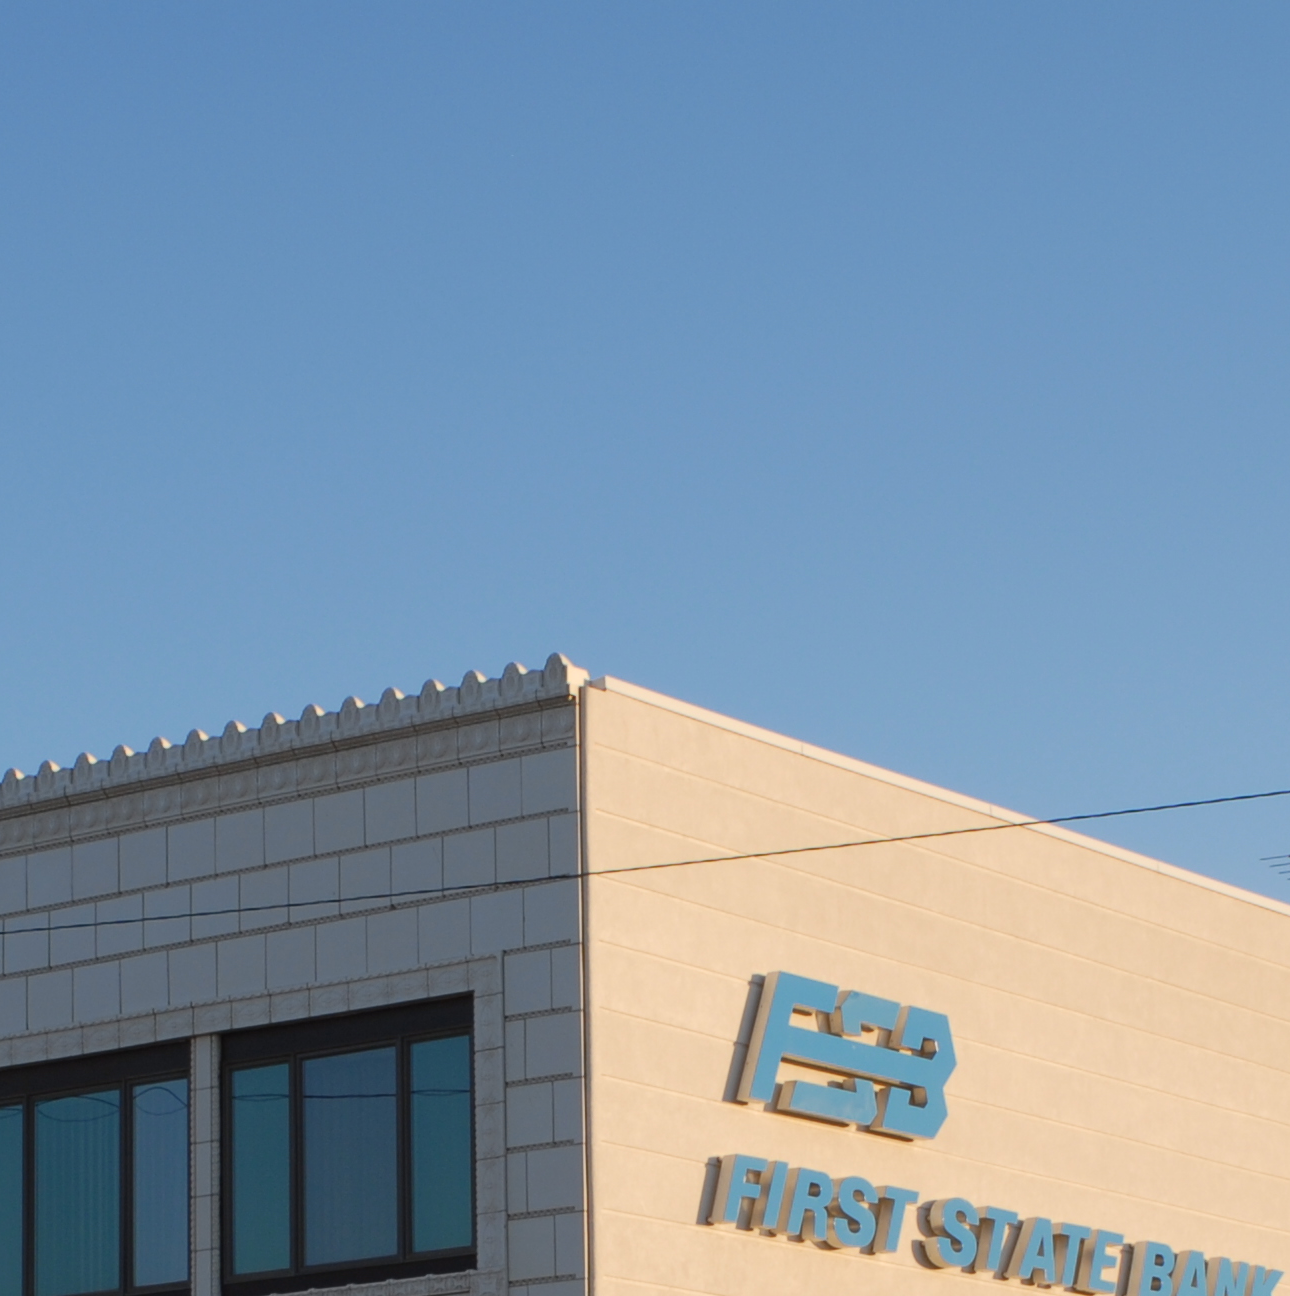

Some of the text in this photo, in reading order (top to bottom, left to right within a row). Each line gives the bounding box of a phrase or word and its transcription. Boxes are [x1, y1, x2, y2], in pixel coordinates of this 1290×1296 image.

[737, 971, 957, 1140] FSB
[715, 1154, 919, 1254] FIRST
[923, 1198, 1124, 1294] STATE
